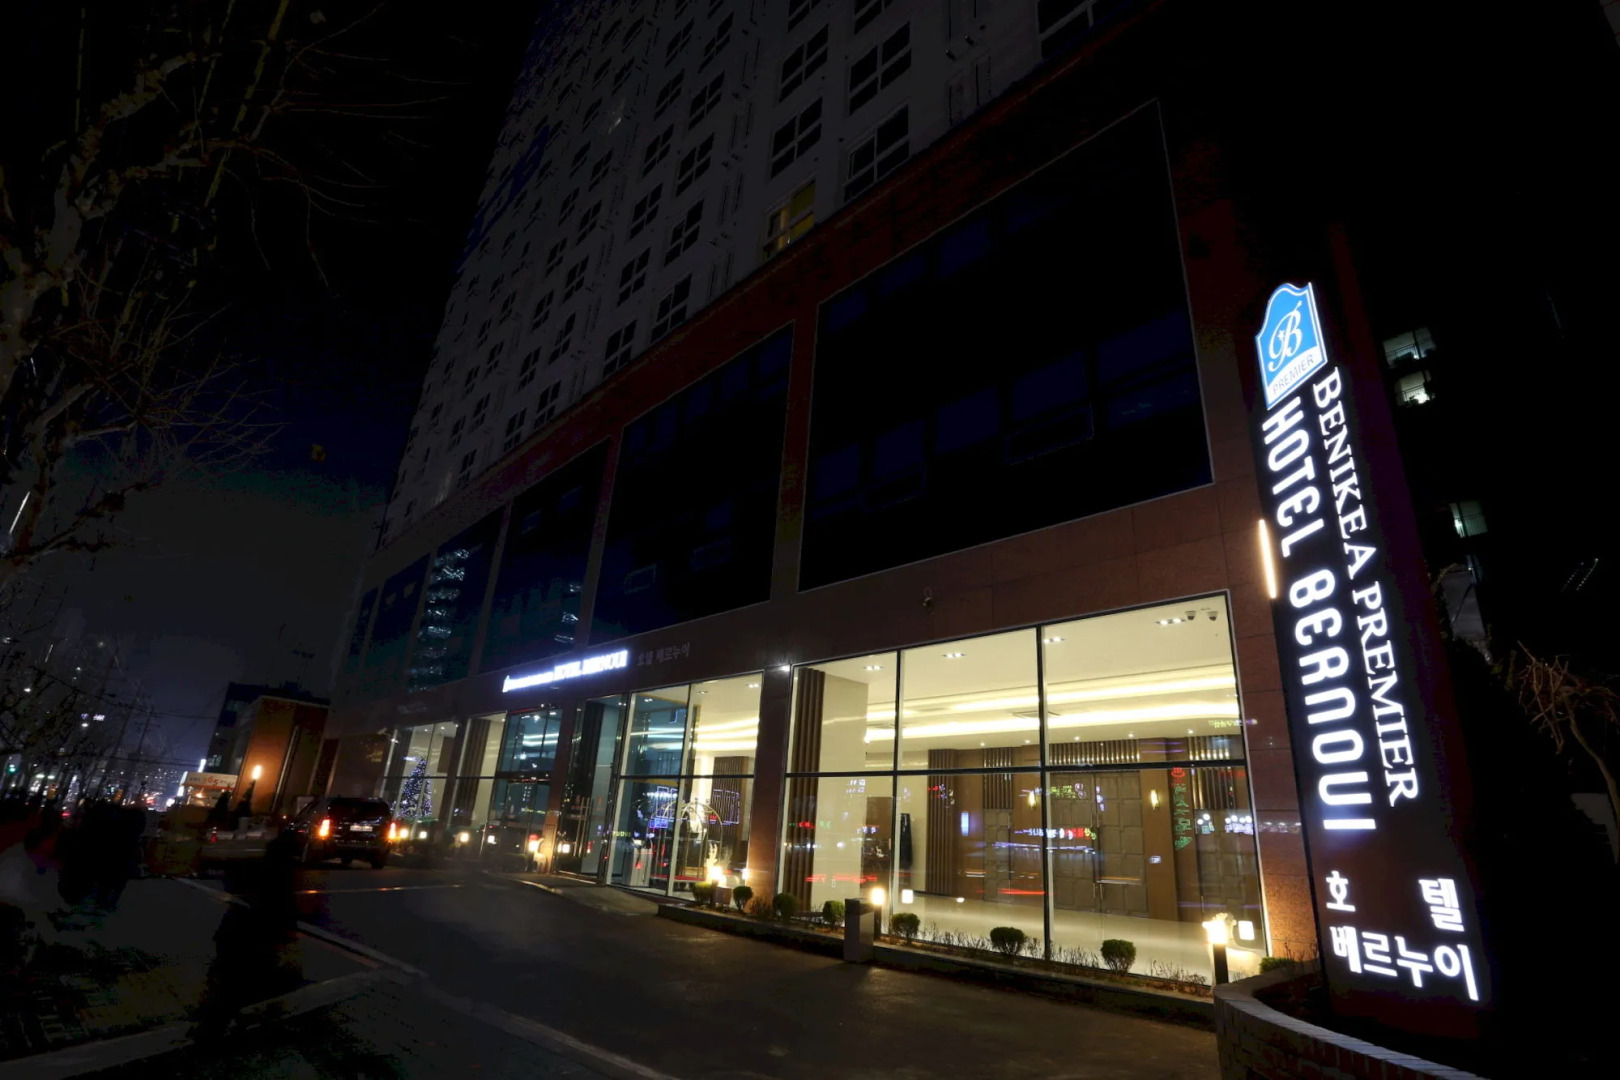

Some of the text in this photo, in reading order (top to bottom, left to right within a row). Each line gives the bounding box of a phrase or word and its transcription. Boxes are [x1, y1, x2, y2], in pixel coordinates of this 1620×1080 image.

[1272, 354, 1315, 395] PREMIER
[1261, 396, 1377, 830] HOTEL BERNOUI
[1312, 366, 1420, 808] BENIKEA PREMIER
[1329, 925, 1479, 1001] 베르누이
